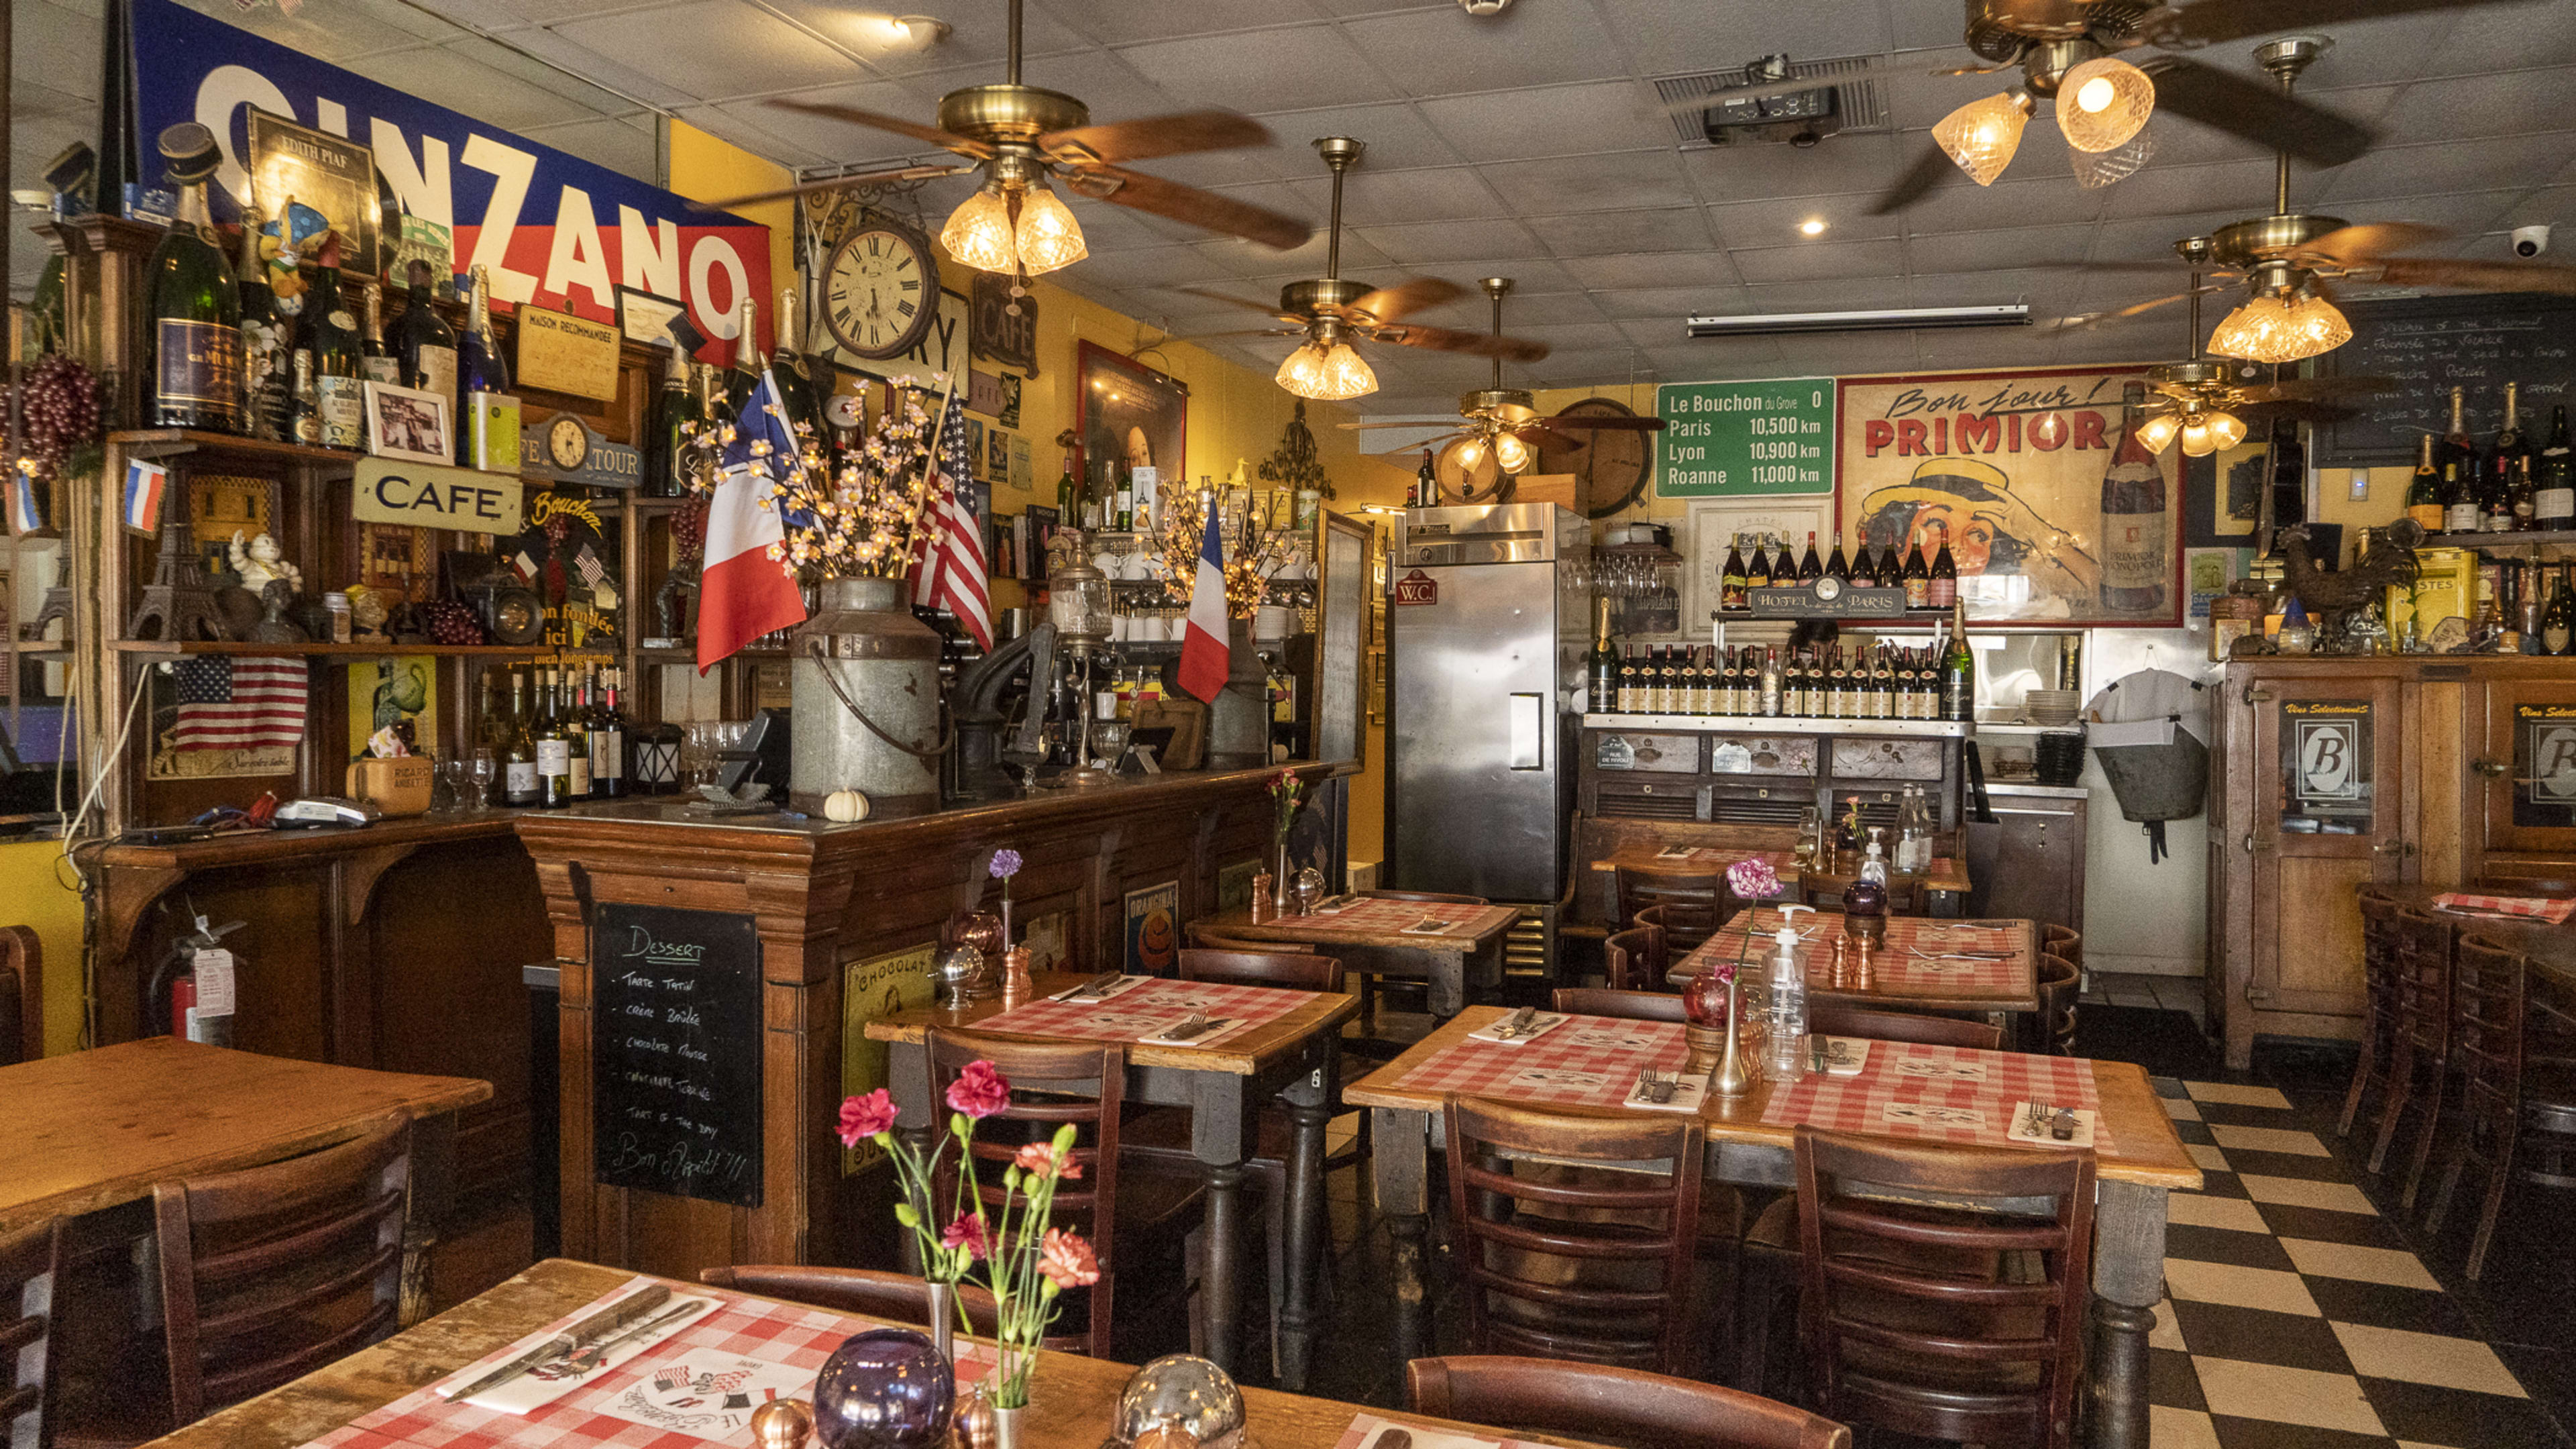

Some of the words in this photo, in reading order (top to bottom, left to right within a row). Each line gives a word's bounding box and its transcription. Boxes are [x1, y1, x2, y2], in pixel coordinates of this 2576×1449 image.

[282, 136, 319, 161] EDITH
[322, 147, 348, 169] PIAF
[195, 63, 750, 341] CNZANO
[529, 313, 557, 331] MAISON
[559, 316, 612, 343] RECOMMANDEE
[1670, 396, 1688, 413] Le
[1693, 394, 1762, 413] Bouchon
[1765, 397, 1775, 410] du
[1776, 396, 1798, 410] Grove
[1812, 390, 1822, 408] 0
[1885, 388, 1970, 419] Bon
[1978, 382, 2078, 417] jour
[1670, 419, 1711, 437] Paris
[1750, 417, 1797, 436] 10,500
[1801, 419, 1821, 434] km
[1866, 411, 2111, 458] PRIMIOR
[592, 448, 638, 476] TOUR
[1669, 443, 1705, 464] Lyon
[1750, 441, 1797, 461] 10,900
[1801, 444, 1820, 458] km
[1668, 468, 1727, 485] Roanne
[1752, 466, 1796, 485] 11,000
[1799, 468, 1819, 482] km
[375, 475, 503, 519] CAFE
[531, 491, 602, 539] Bouchon
[1399, 584, 1433, 601] W.C.
[1758, 594, 1811, 608] HOTEL
[1847, 594, 1894, 608] PARIS
[545, 627, 567, 645] ici
[2285, 703, 2308, 714] Vins
[2519, 706, 2542, 717] Vins
[2306, 737, 2345, 775] B
[394, 767, 430, 779] RICARD
[1130, 890, 1174, 919] ORANGINA
[622, 925, 706, 958] DESSERT
[859, 959, 926, 992] CHOCOLAT
